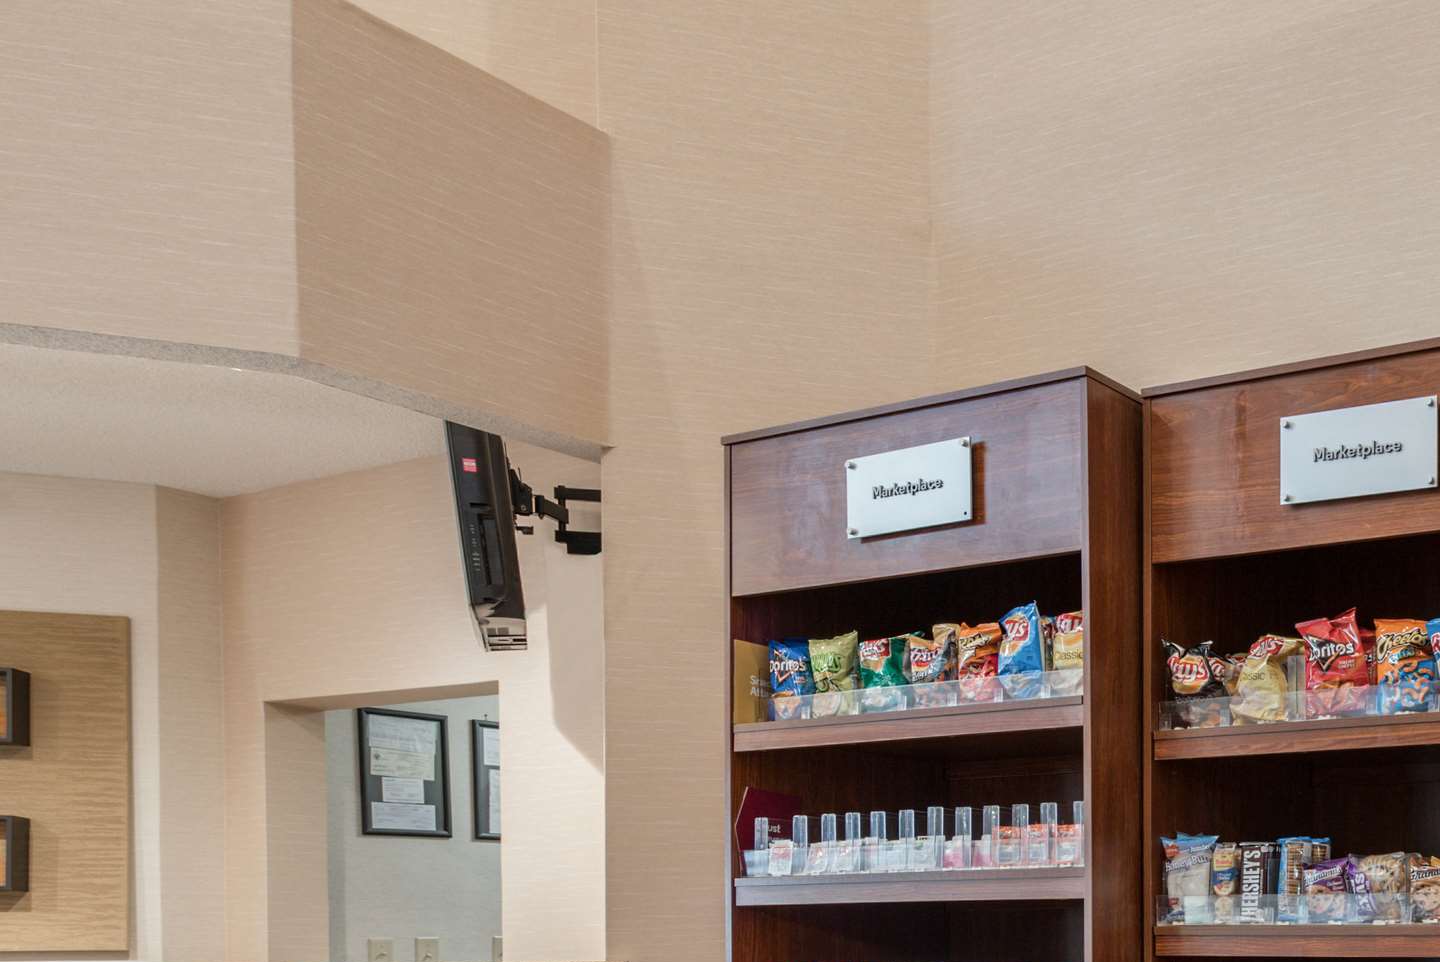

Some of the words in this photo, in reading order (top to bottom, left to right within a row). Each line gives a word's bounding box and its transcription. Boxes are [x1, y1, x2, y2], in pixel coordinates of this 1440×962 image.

[1312, 440, 1402, 462] Marketplace
[872, 479, 944, 500] Marketplace
[1310, 642, 1355, 662] Doritos
[769, 659, 807, 673] Doritos
[1241, 850, 1262, 914] HERSHEY'S
